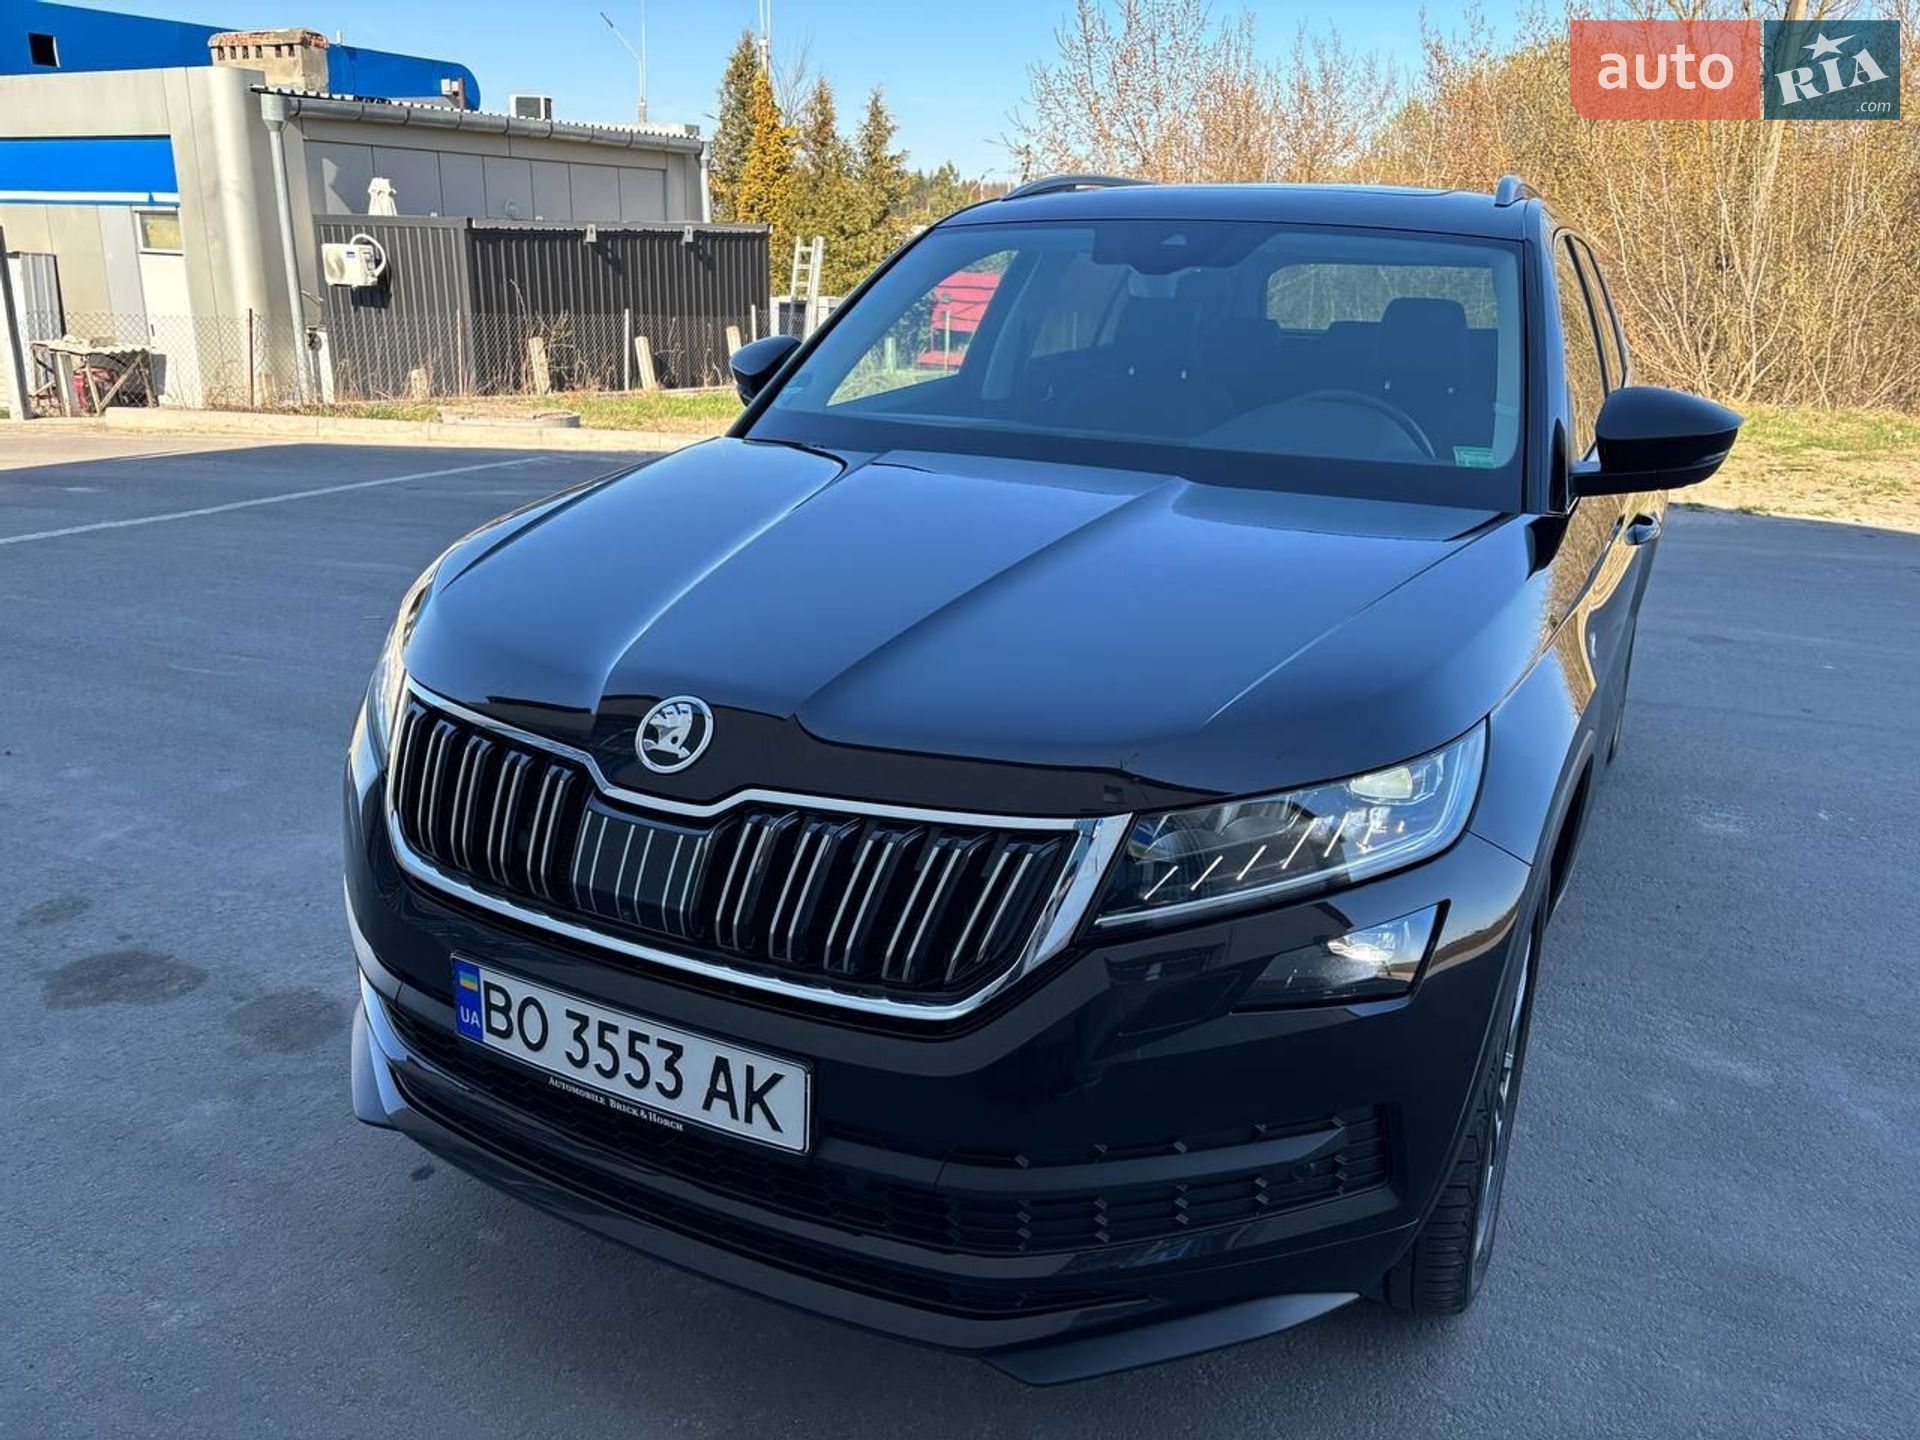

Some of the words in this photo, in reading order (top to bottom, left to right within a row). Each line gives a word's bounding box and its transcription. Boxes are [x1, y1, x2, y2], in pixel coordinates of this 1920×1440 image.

[460, 1005, 481, 1028] UA
[483, 980, 549, 1052] BO
[565, 1009, 684, 1099] 3553
[702, 1055, 786, 1133] AK
